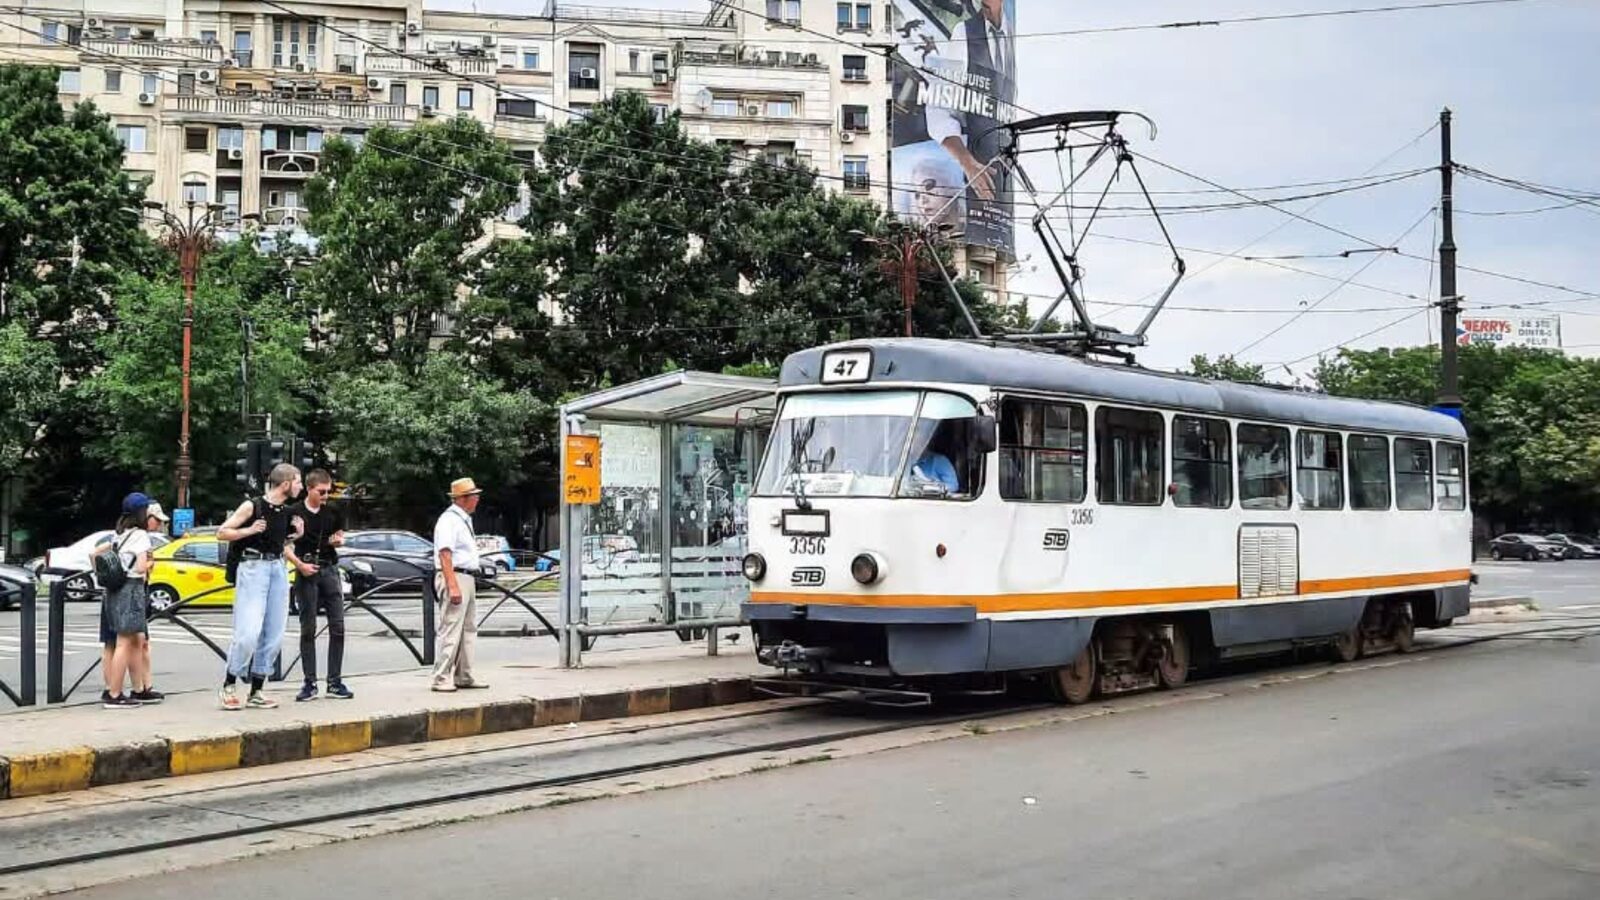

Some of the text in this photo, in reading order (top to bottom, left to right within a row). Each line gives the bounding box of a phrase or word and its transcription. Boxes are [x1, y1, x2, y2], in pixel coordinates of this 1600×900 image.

[833, 359, 858, 376] 47
[1070, 508, 1094, 525] 3356
[789, 536, 826, 555] 3356
[1043, 531, 1068, 548] STB
[791, 569, 823, 584] STB
